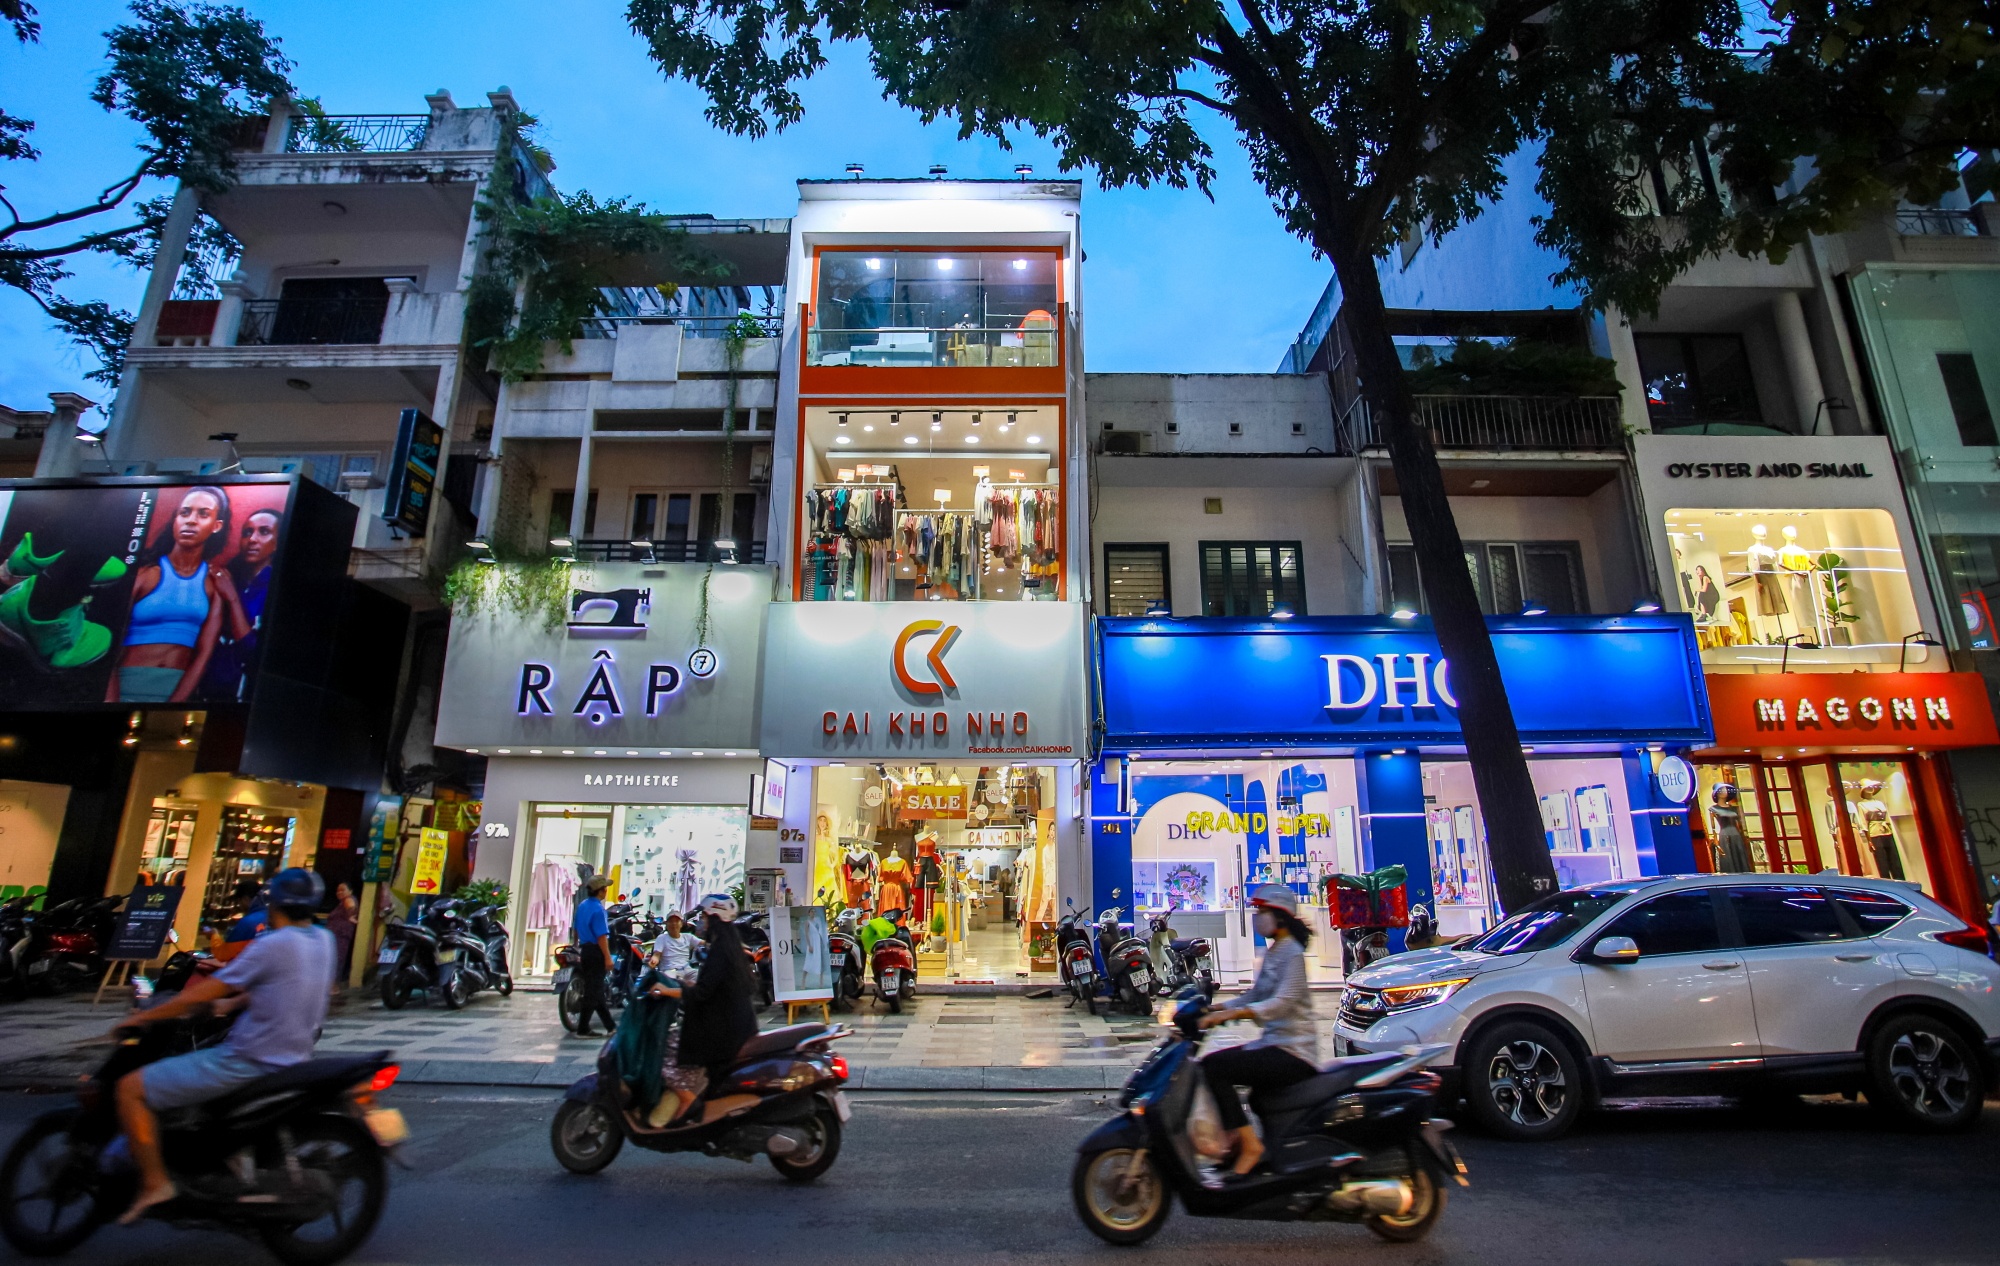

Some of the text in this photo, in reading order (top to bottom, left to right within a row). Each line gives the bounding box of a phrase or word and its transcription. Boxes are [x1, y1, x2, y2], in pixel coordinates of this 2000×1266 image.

[1667, 463, 1873, 479] OYSTER AND SNAIL
[1758, 696, 1951, 722] MAGONN
[822, 711, 1029, 735] CAI KHO NHO
[968, 745, 1072, 754] Facebook.com/CAIKHONHO
[584, 774, 680, 787] RAPTHIETKE
[1661, 772, 1685, 787] DHC
[865, 792, 883, 800] SALE
[987, 788, 1004, 797] SALE
[907, 795, 960, 810] SALE
[1185, 811, 1267, 834] GRAND
[644, 877, 703, 885] RAPTHIETKE
[1533, 878, 1551, 890] 37
